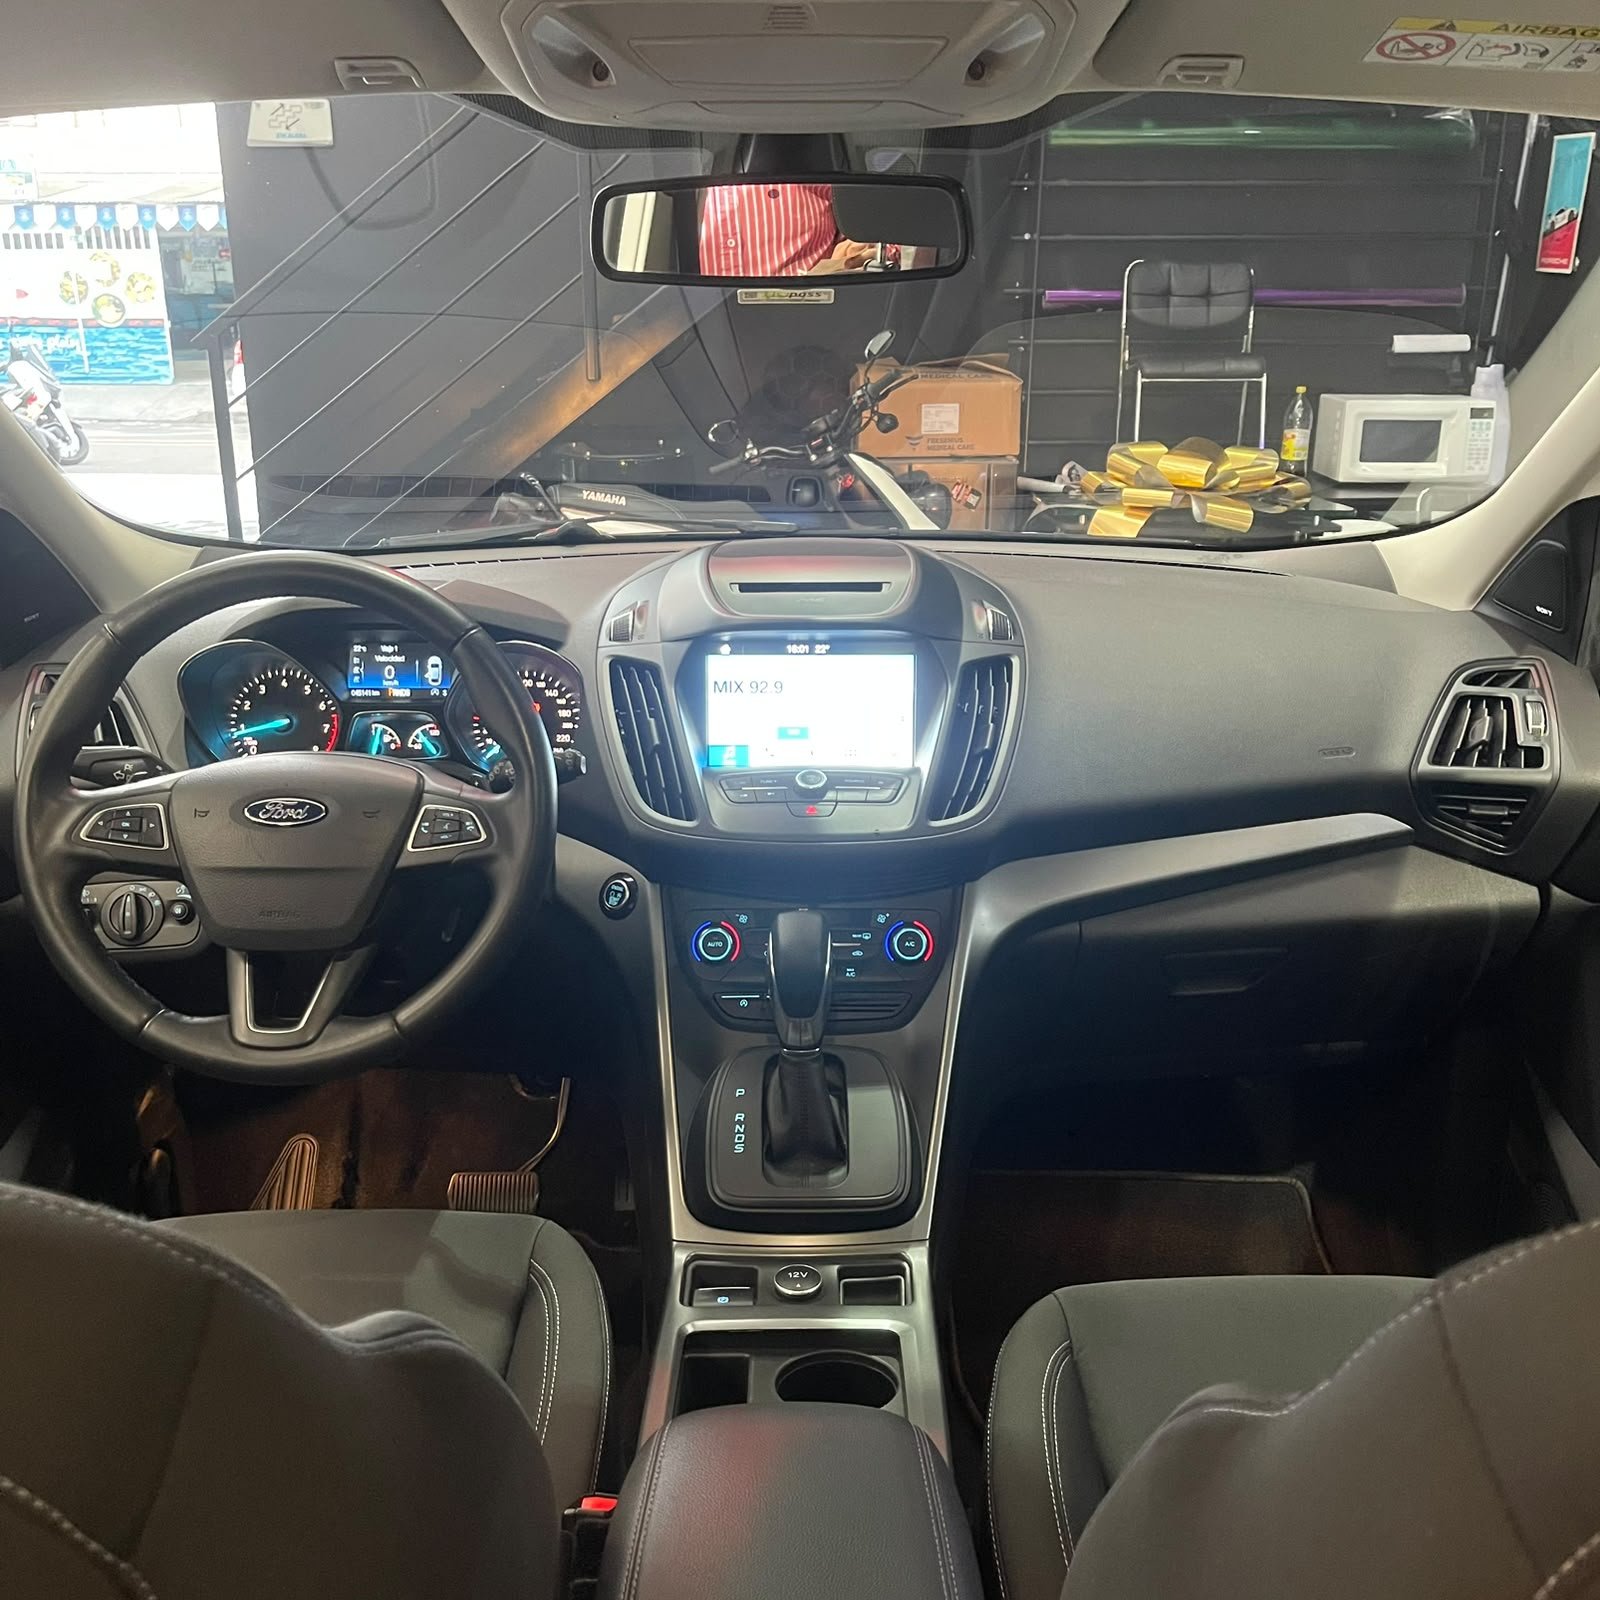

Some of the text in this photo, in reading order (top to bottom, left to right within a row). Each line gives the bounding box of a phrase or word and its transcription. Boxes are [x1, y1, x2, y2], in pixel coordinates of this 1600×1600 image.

[1490, 23, 1600, 38] AIRBAG
[582, 489, 627, 506] YAMAHA
[384, 665, 395, 679] 0
[281, 678, 288, 688] 4
[713, 680, 784, 694] MIX 92.9
[258, 684, 266, 695] 3
[304, 685, 312, 695] 5
[544, 689, 559, 697] 140
[243, 700, 251, 711] 2
[319, 701, 327, 711] 6
[322, 724, 331, 733] 7
[556, 734, 571, 743] 220
[249, 745, 258, 755] 0
[735, 1088, 746, 1098] P
[734, 1112, 745, 1122] R
[734, 1124, 745, 1133] N
[734, 1133, 745, 1143] D
[733, 1143, 745, 1153] S
[787, 1271, 809, 1279] 12V
